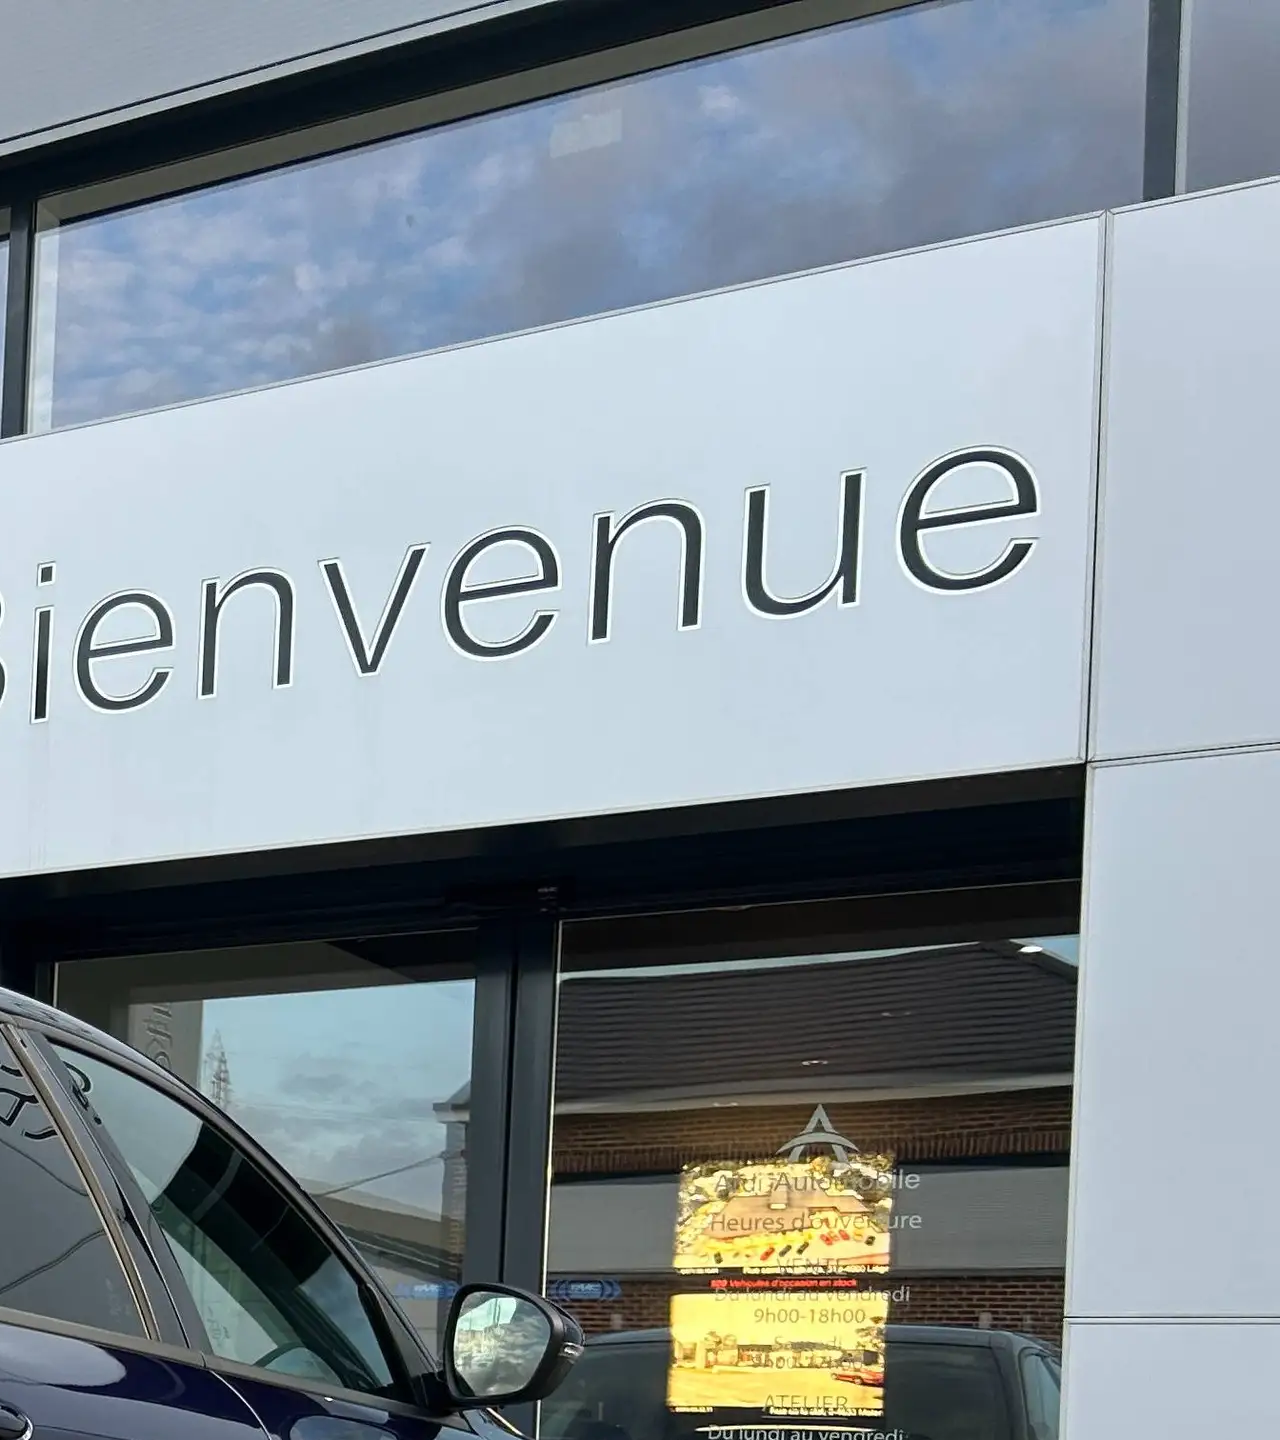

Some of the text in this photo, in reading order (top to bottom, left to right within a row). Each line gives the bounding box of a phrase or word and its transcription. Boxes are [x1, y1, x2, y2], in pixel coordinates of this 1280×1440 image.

[710, 1212, 922, 1232] Heures d'ouverure
[821, 1285, 910, 1303] vendredi
[753, 1307, 866, 1324] 9h00-18h00
[762, 1394, 848, 1411] ATELIER
